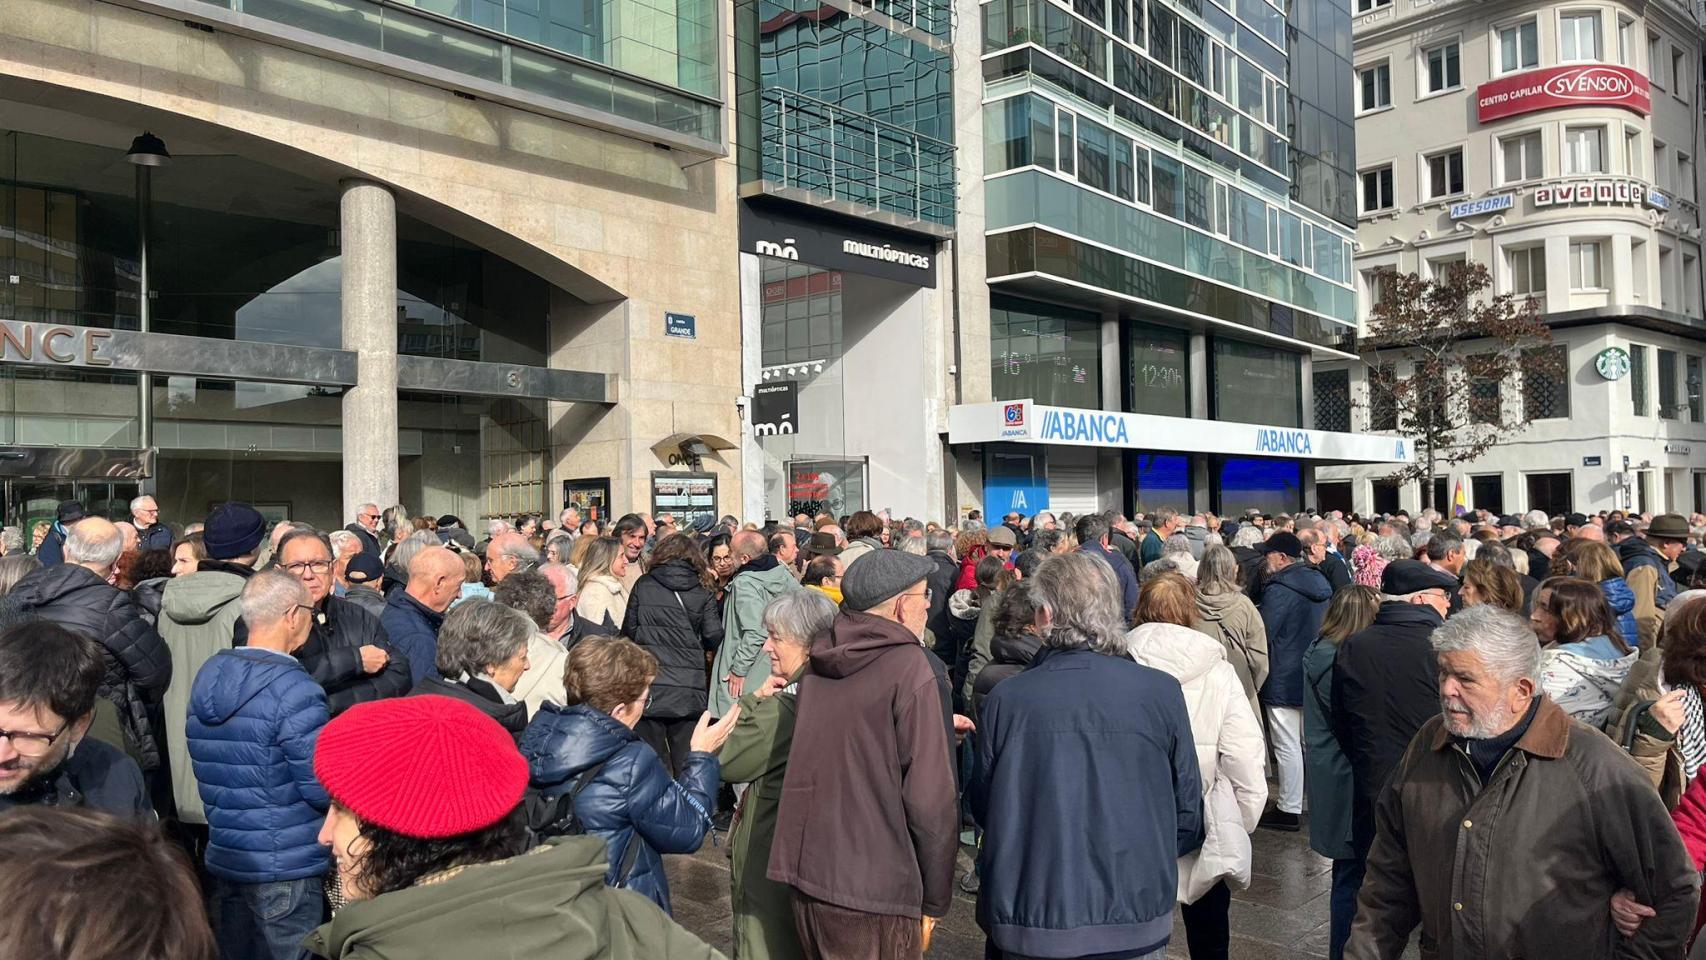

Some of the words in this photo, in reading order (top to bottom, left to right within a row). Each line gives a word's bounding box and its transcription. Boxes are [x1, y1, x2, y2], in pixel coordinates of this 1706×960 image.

[1479, 92, 1508, 107] CENTRO
[1510, 85, 1543, 100] CAPILAR
[1555, 76, 1628, 94] SVENSON
[1451, 195, 1512, 217] ASESORIA
[1536, 184, 1640, 202] avante
[670, 326, 692, 336] GRANDE
[668, 453, 701, 466] ONCE
